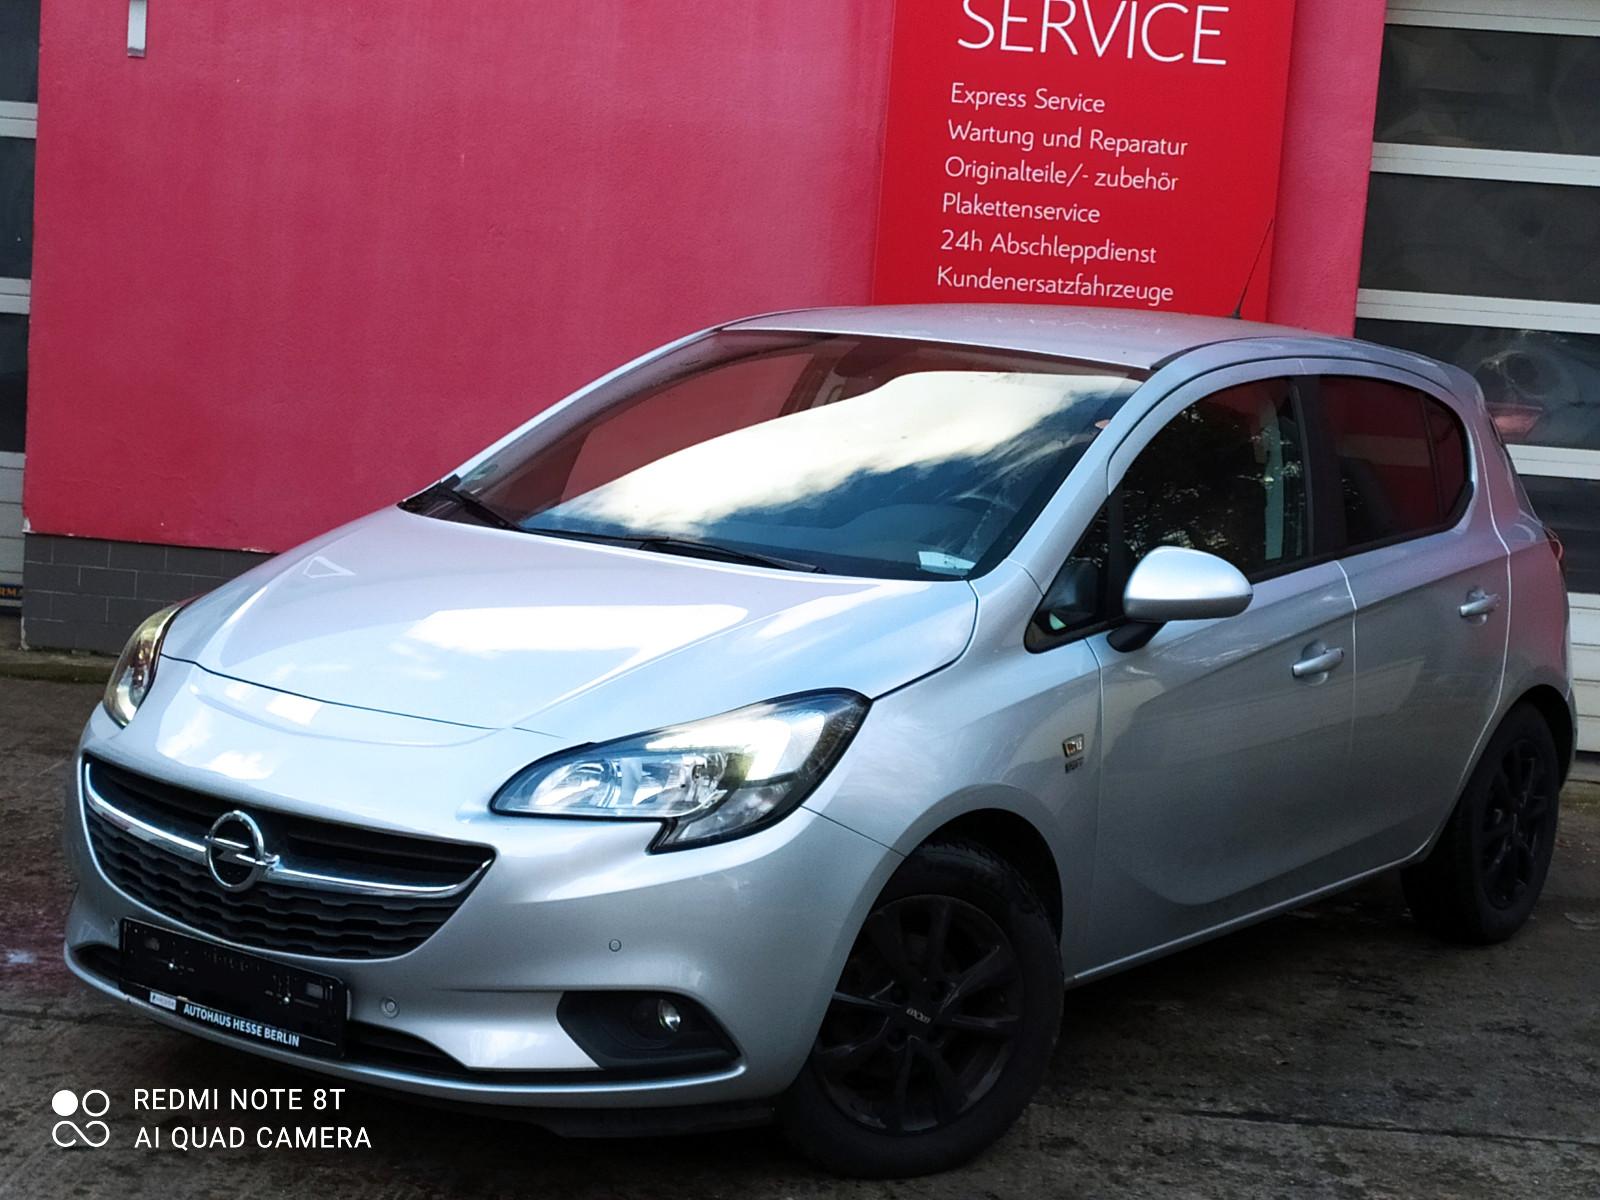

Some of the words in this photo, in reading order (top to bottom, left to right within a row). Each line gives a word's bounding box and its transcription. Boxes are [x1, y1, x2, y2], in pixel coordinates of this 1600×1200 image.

[957, 0, 1230, 66] SERVICE
[951, 82, 1027, 111] Express
[1034, 87, 1106, 113] Service
[948, 119, 1034, 152] Wartung
[1042, 126, 1082, 149] und
[1089, 129, 1188, 158] Reparatur
[945, 156, 1089, 187] Originalteile/-
[1094, 166, 1179, 191] zubehör
[943, 192, 1101, 223] Plakettenservice
[940, 229, 983, 252] 24h
[989, 232, 1157, 265] Abschleppdienst
[937, 265, 1174, 307] Kundenersatzfahrzeuge
[183, 1003, 231, 1028] AUTOHAUS
[232, 1018, 263, 1037] HESSE
[264, 1026, 300, 1047] BERLIN
